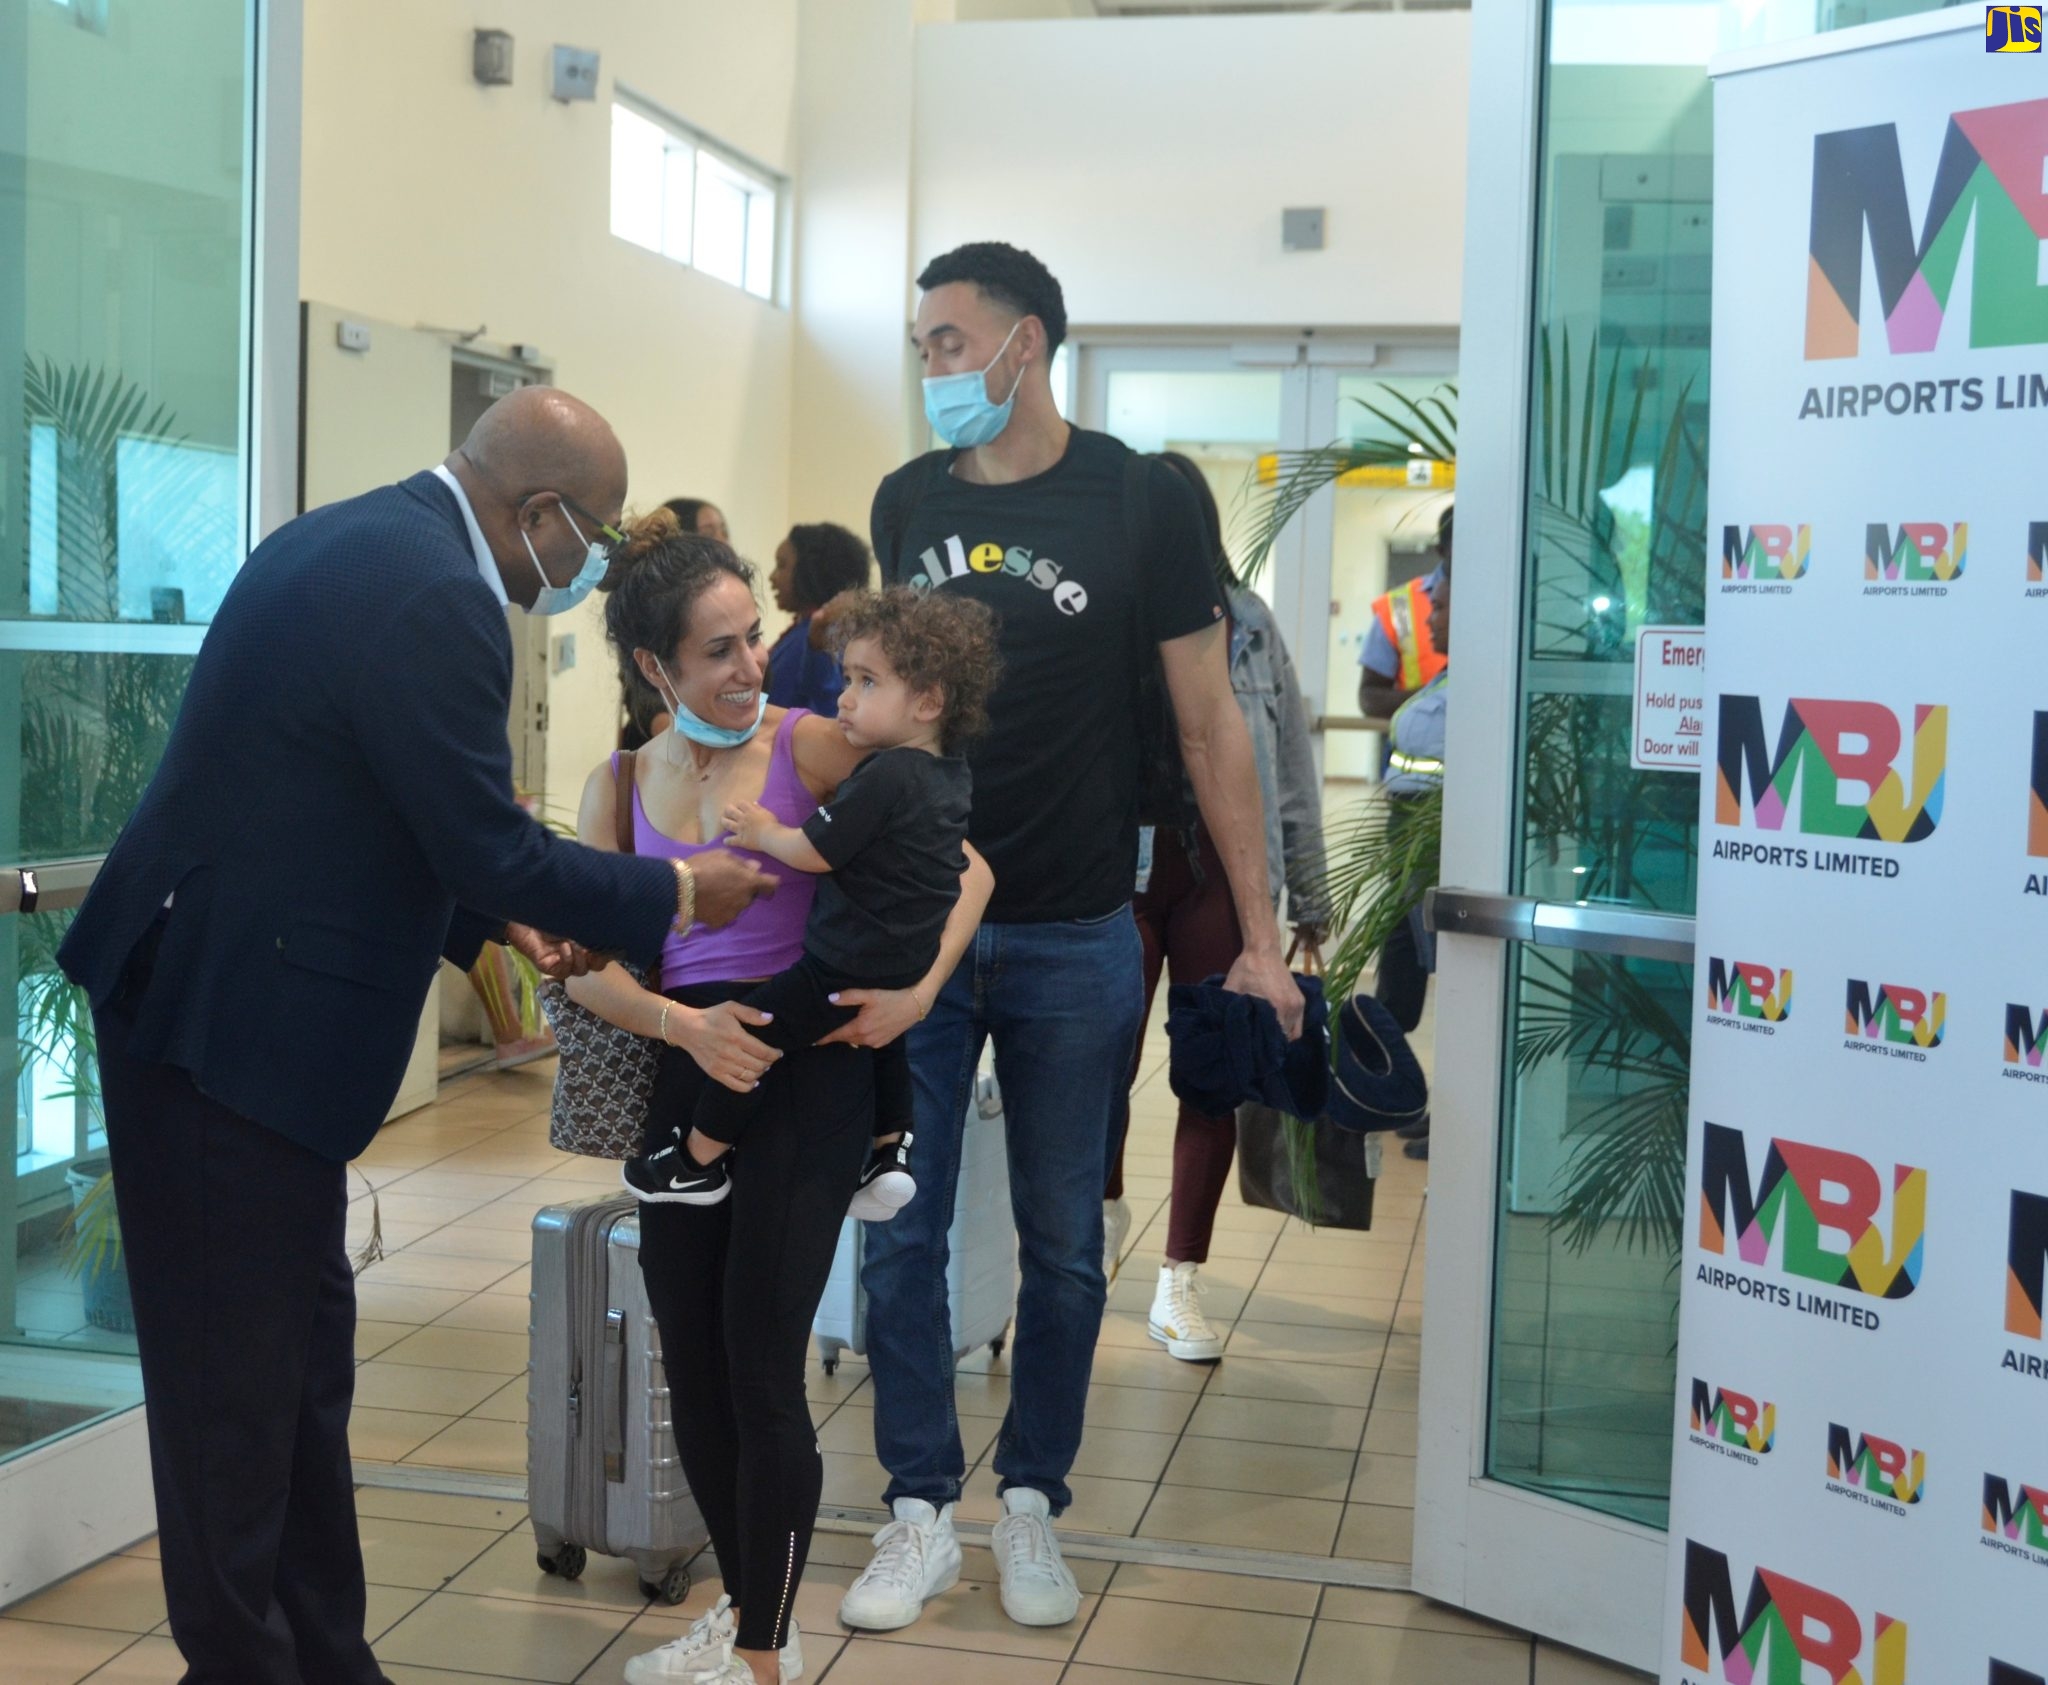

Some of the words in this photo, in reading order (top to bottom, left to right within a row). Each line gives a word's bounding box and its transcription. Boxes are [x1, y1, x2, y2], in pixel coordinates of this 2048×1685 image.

[1800, 377, 1984, 420] AIRPORTS
[1722, 523, 1811, 581] MBJ
[1864, 522, 1968, 582] MBJ
[908, 534, 1088, 616] ellesse
[1720, 585, 1758, 595] AIRPORTS
[1759, 585, 1793, 595] LIMITED
[1863, 586, 1909, 597] AIRPORTS
[1910, 586, 1948, 597] LIMITED
[1662, 639, 1705, 672] Emer
[1646, 692, 1675, 708] Hold
[1679, 697, 1702, 712] pus
[1679, 716, 1702, 731] Ala
[1644, 738, 1674, 755] Door
[1677, 742, 1699, 756] will
[1715, 694, 1948, 843] MBJ
[1713, 839, 1808, 868] AIRPORTS
[1814, 851, 1900, 878] LIMITED
[1708, 956, 1793, 1023] MBJ
[1706, 1015, 1741, 1031] AIRPORTS
[1742, 1021, 1775, 1036] LIMITED
[1844, 978, 1947, 1048] MBJ
[1843, 1040, 1889, 1057] AIRPORTS
[1890, 1048, 1927, 1063] LIMITED
[2001, 1067, 2048, 1085] AIRPORT
[1699, 1121, 1927, 1300] MBJ
[1697, 1264, 1790, 1307] AIRPORTS
[1797, 1292, 1880, 1331] LIMITED
[1690, 1377, 1776, 1454] MBJ
[1688, 1434, 1725, 1455] AIRPORTS
[1726, 1448, 1759, 1466] LIMITED
[1826, 1422, 1925, 1505] MBJ
[1825, 1481, 1869, 1504] AIRPORTS
[1870, 1497, 1907, 1517] LIMITED
[1979, 1535, 2030, 1560] AIRPORTS
